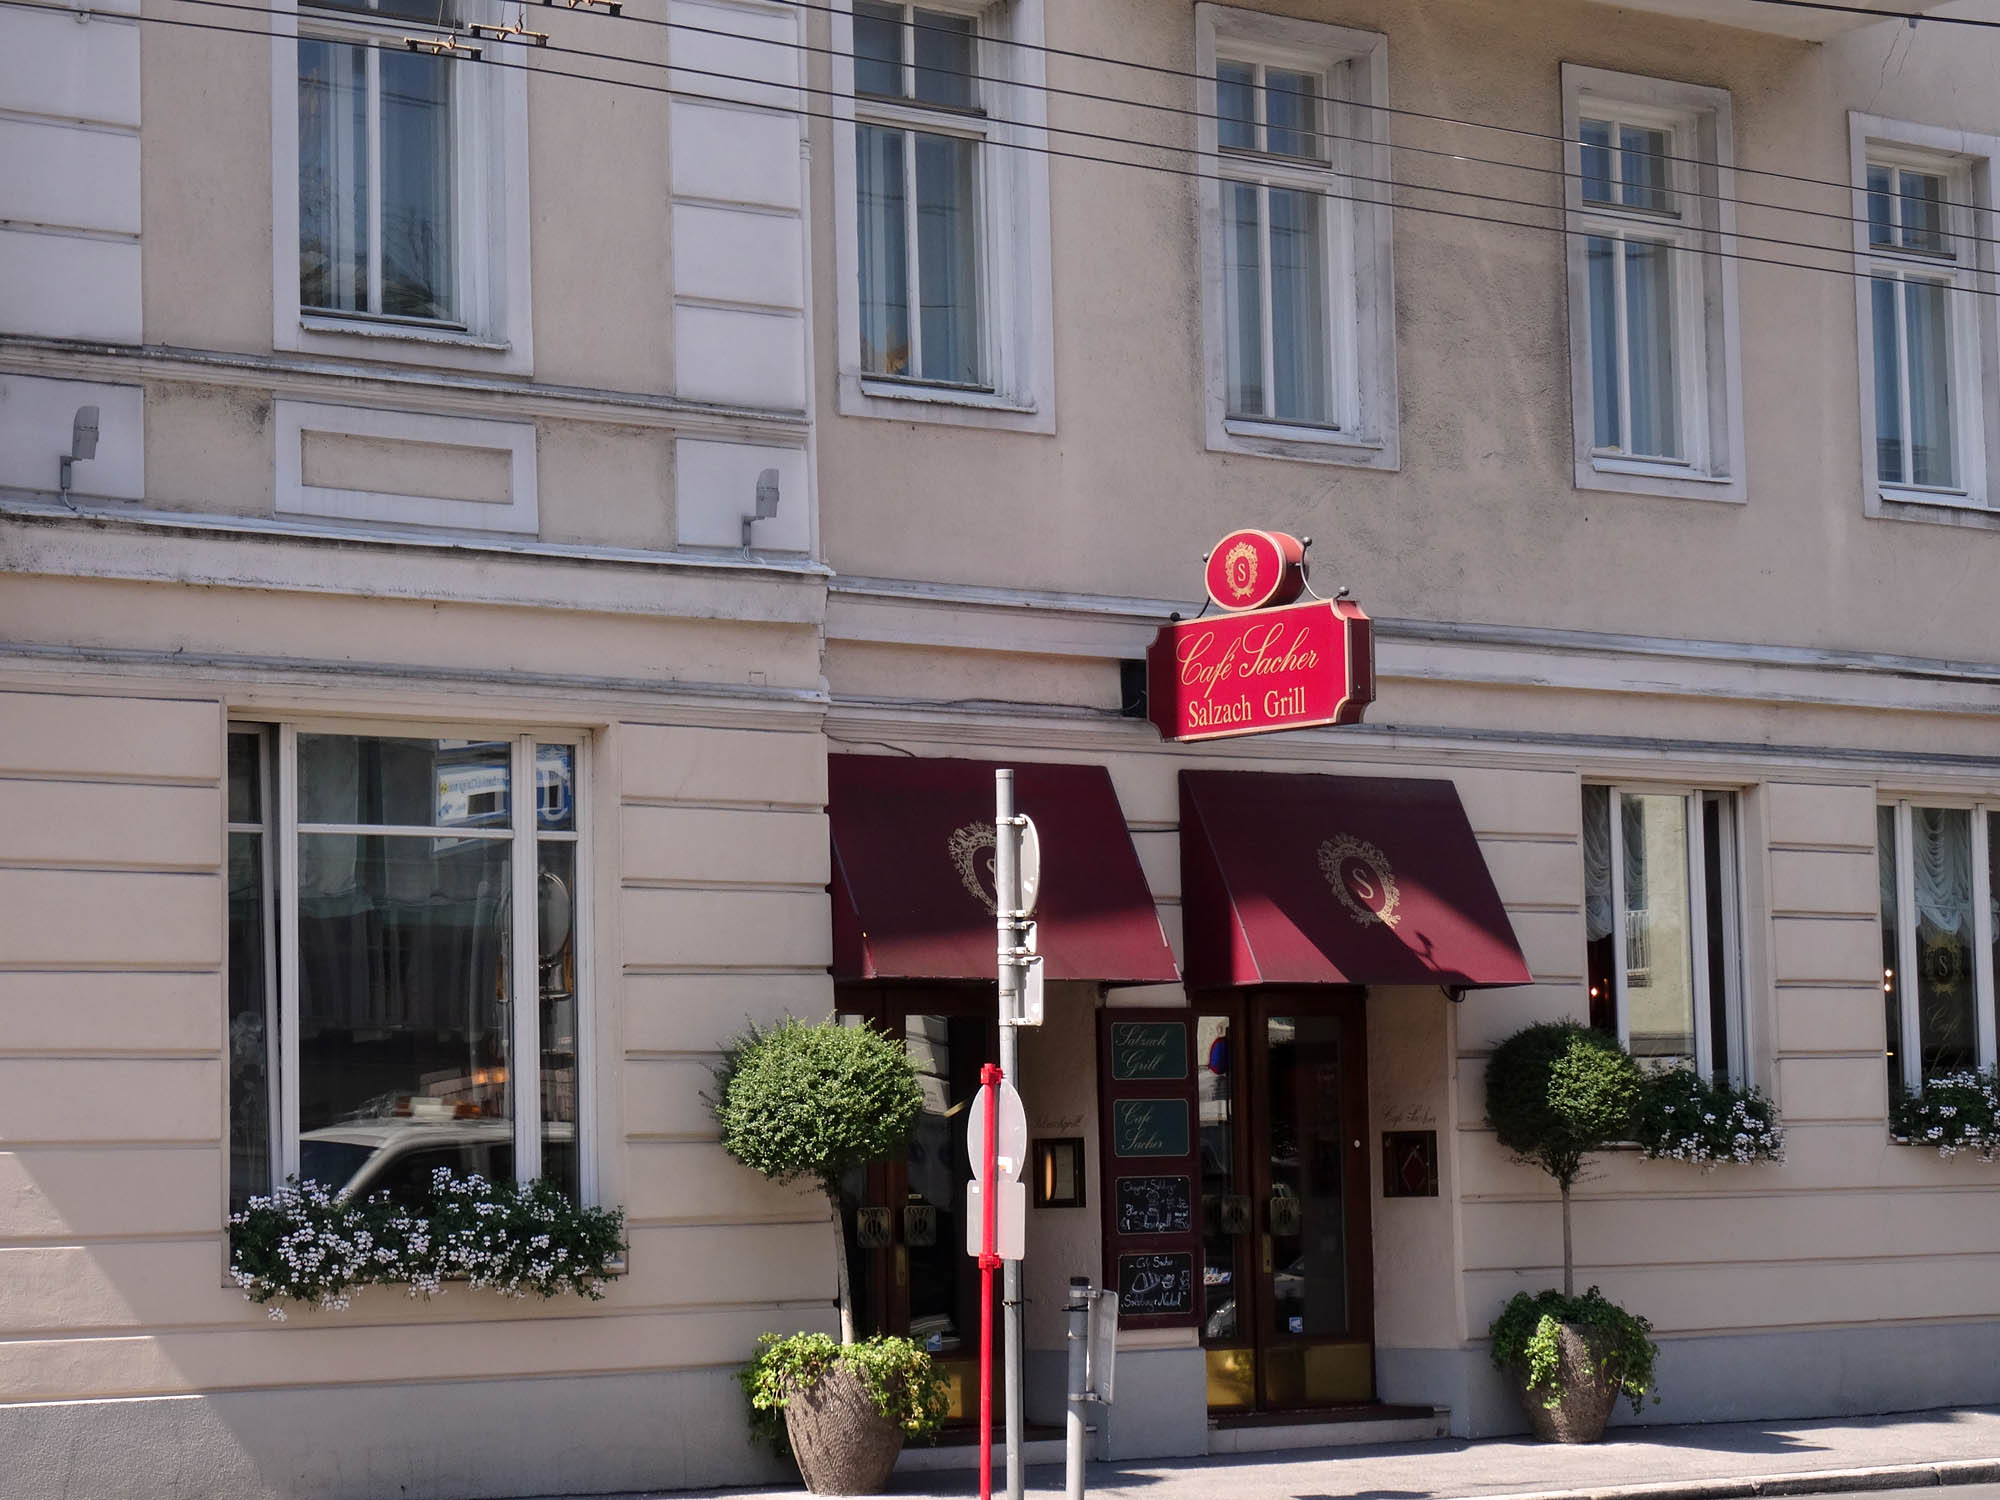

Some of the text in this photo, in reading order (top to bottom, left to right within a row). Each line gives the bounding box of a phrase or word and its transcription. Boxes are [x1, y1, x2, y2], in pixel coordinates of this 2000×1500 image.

[1238, 563, 1246, 581] S
[1176, 622, 1319, 698] Café Sacher
[1188, 686, 1306, 728] Salzach Grill
[1352, 868, 1374, 898] S
